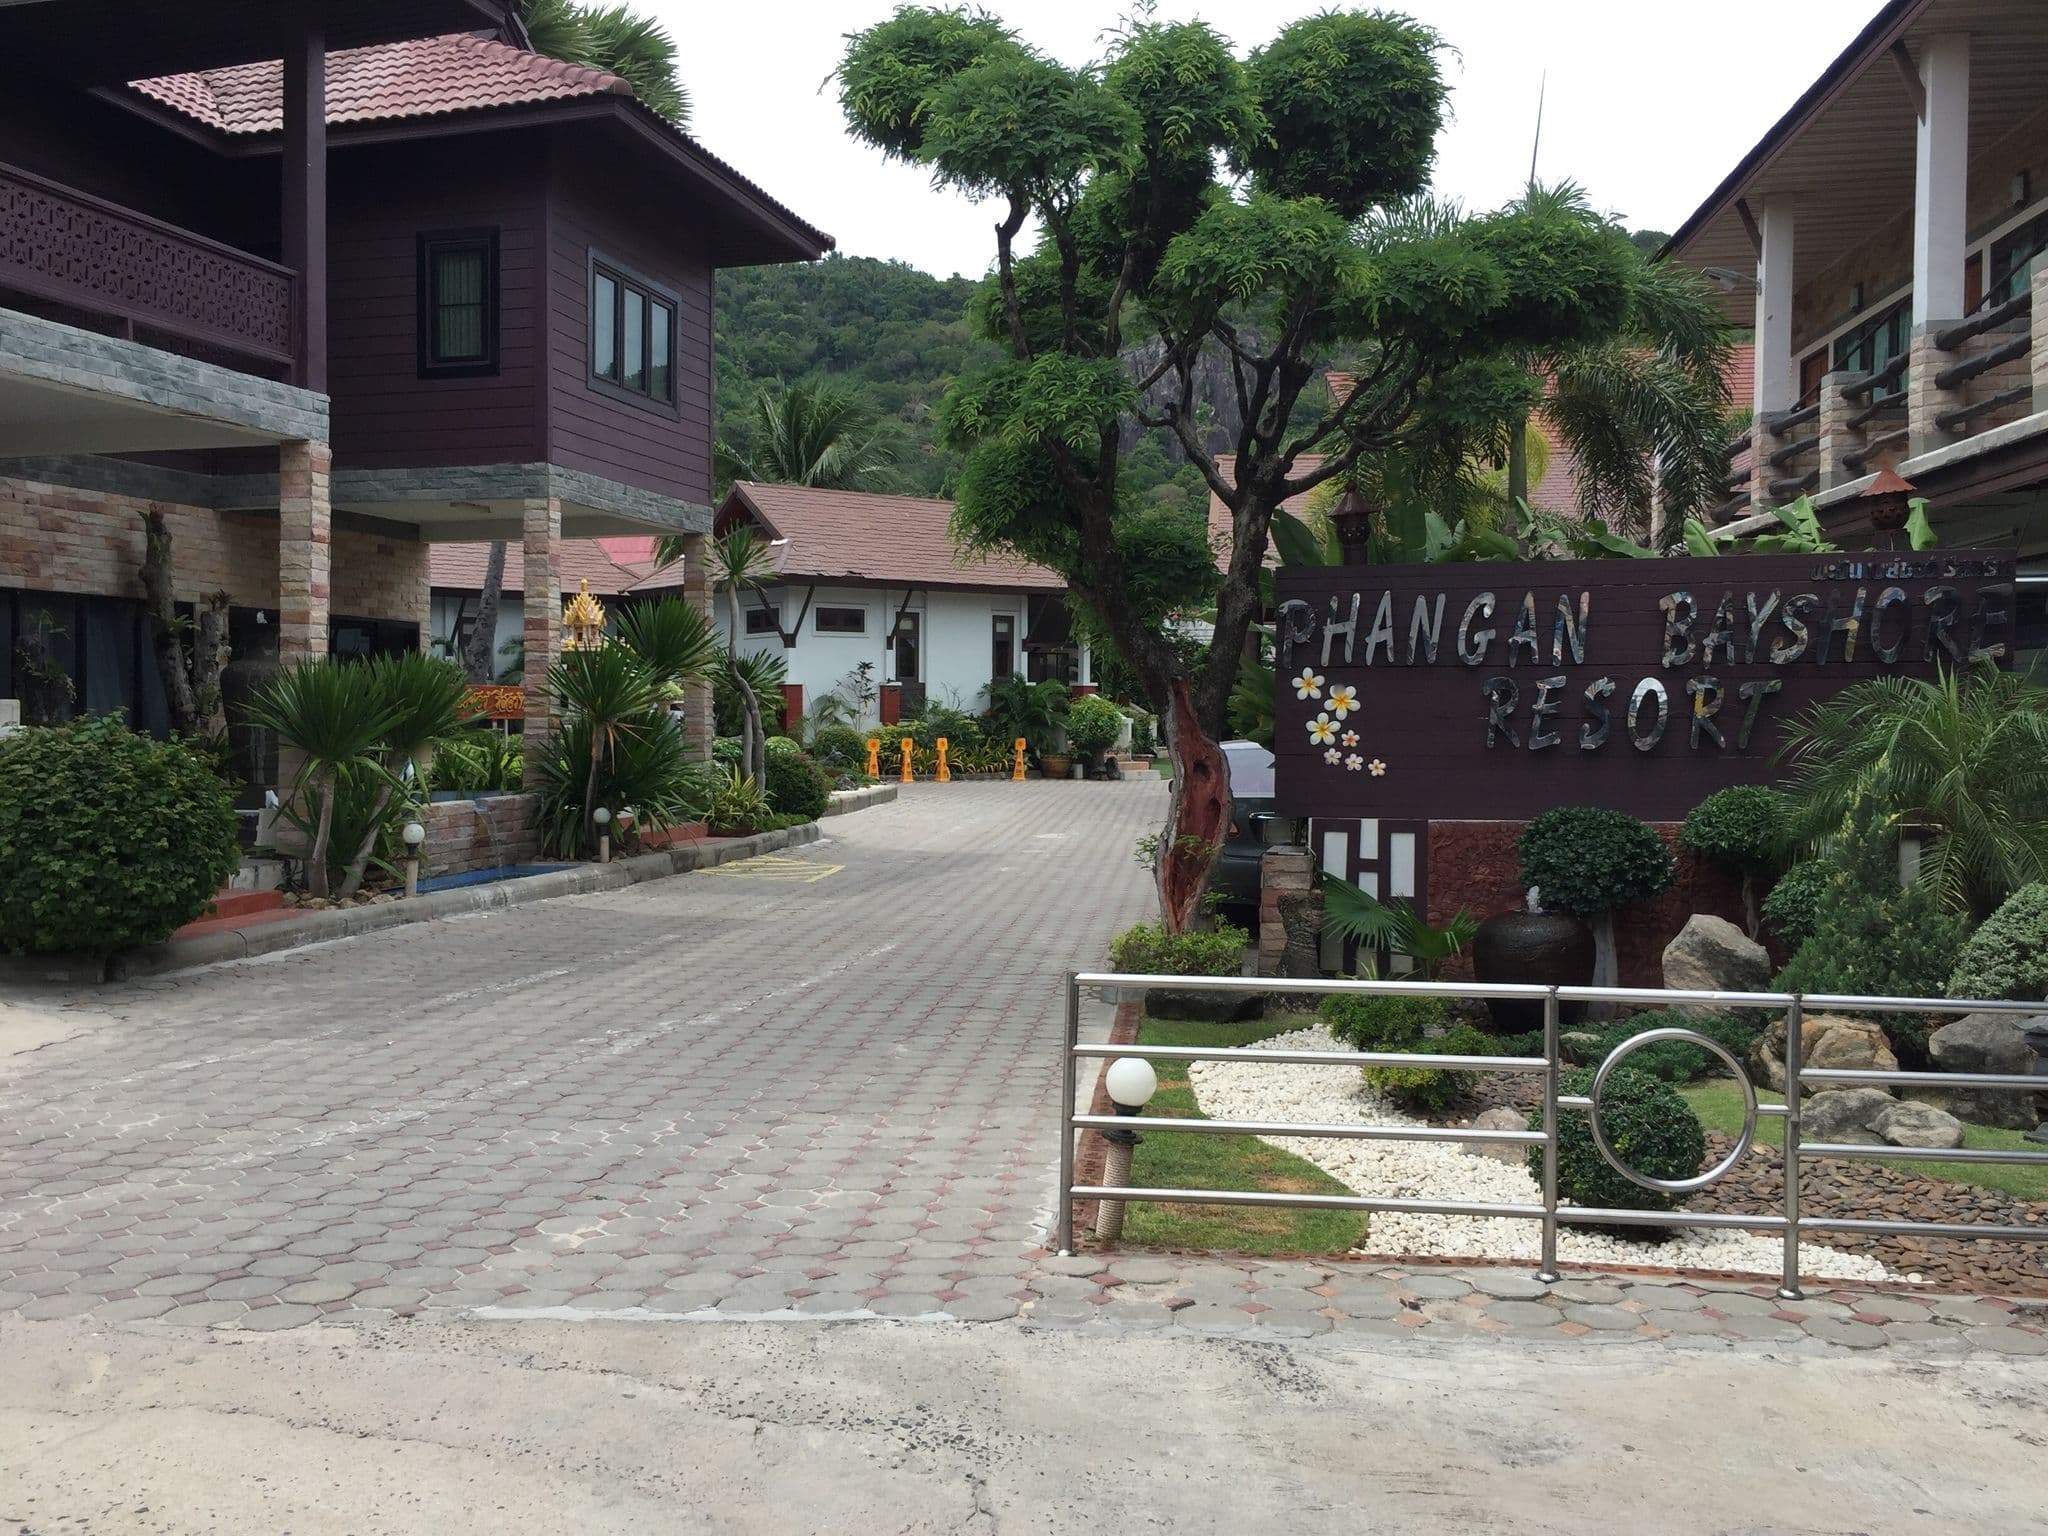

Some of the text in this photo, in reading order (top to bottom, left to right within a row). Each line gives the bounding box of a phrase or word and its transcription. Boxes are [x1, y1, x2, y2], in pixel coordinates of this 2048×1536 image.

[1278, 587, 2010, 668] PHANGAN BAYSHORE
[1482, 675, 1783, 752] RESORT
